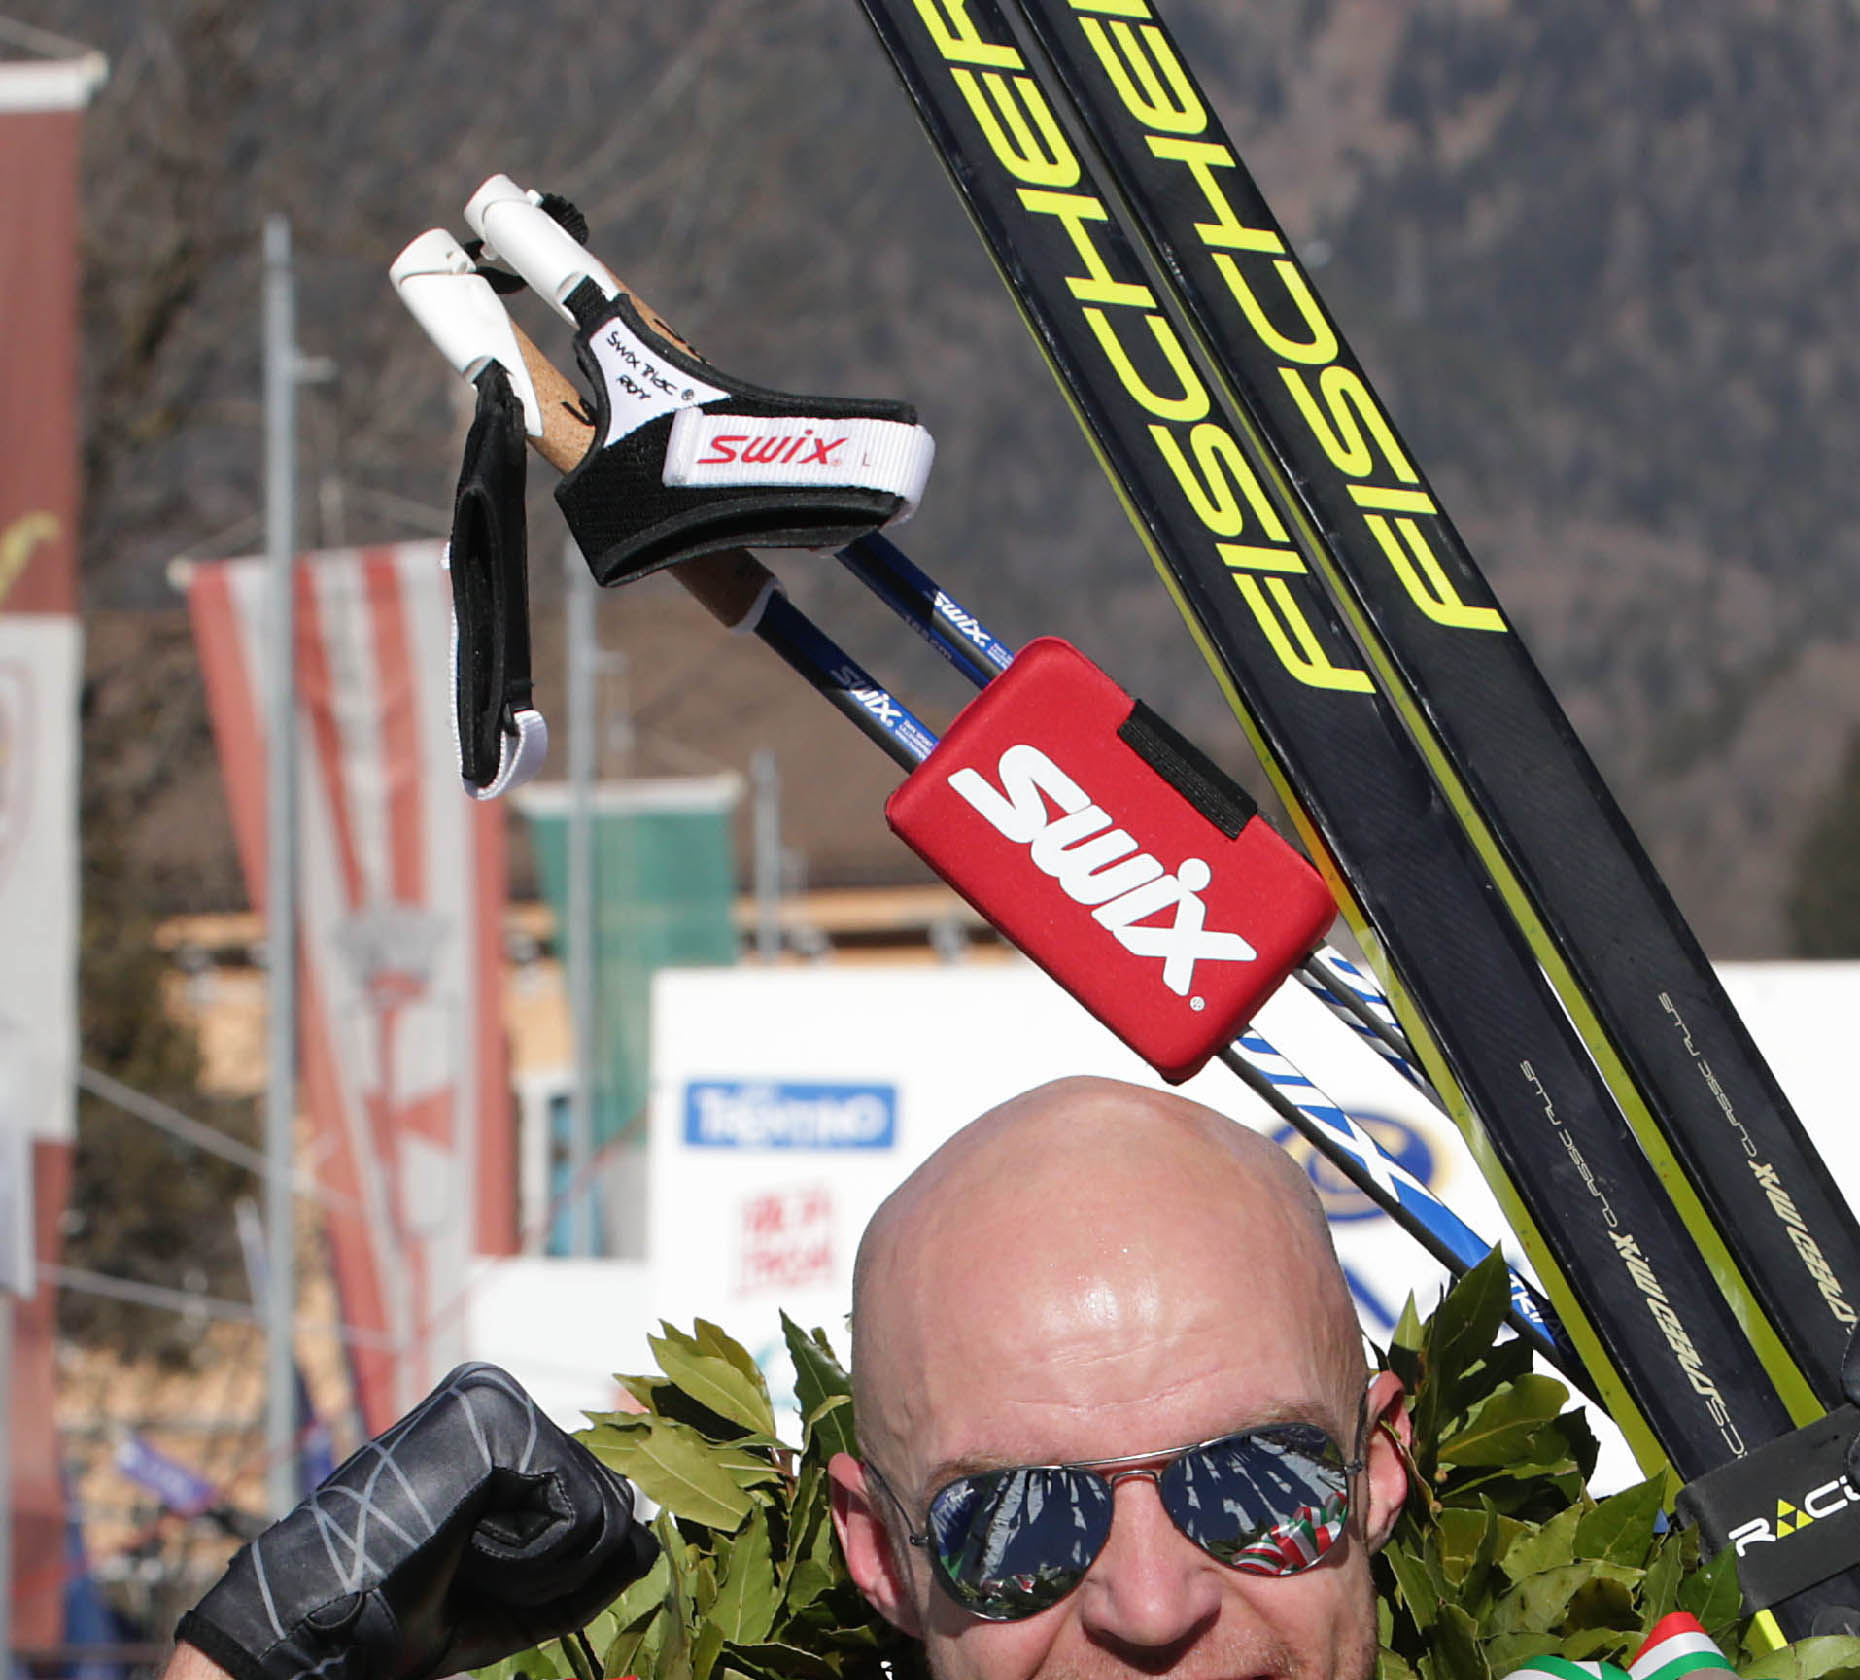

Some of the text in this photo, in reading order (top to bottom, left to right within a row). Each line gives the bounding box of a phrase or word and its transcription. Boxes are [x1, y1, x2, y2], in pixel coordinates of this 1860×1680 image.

[1067, 0, 1508, 632] FISCHE
[1660, 992, 1699, 1057] PLUS
[1520, 1061, 1561, 1127] PLUS
[1699, 1059, 1757, 1157] CLASSIC
[1560, 1129, 1618, 1228] CLASSIC
